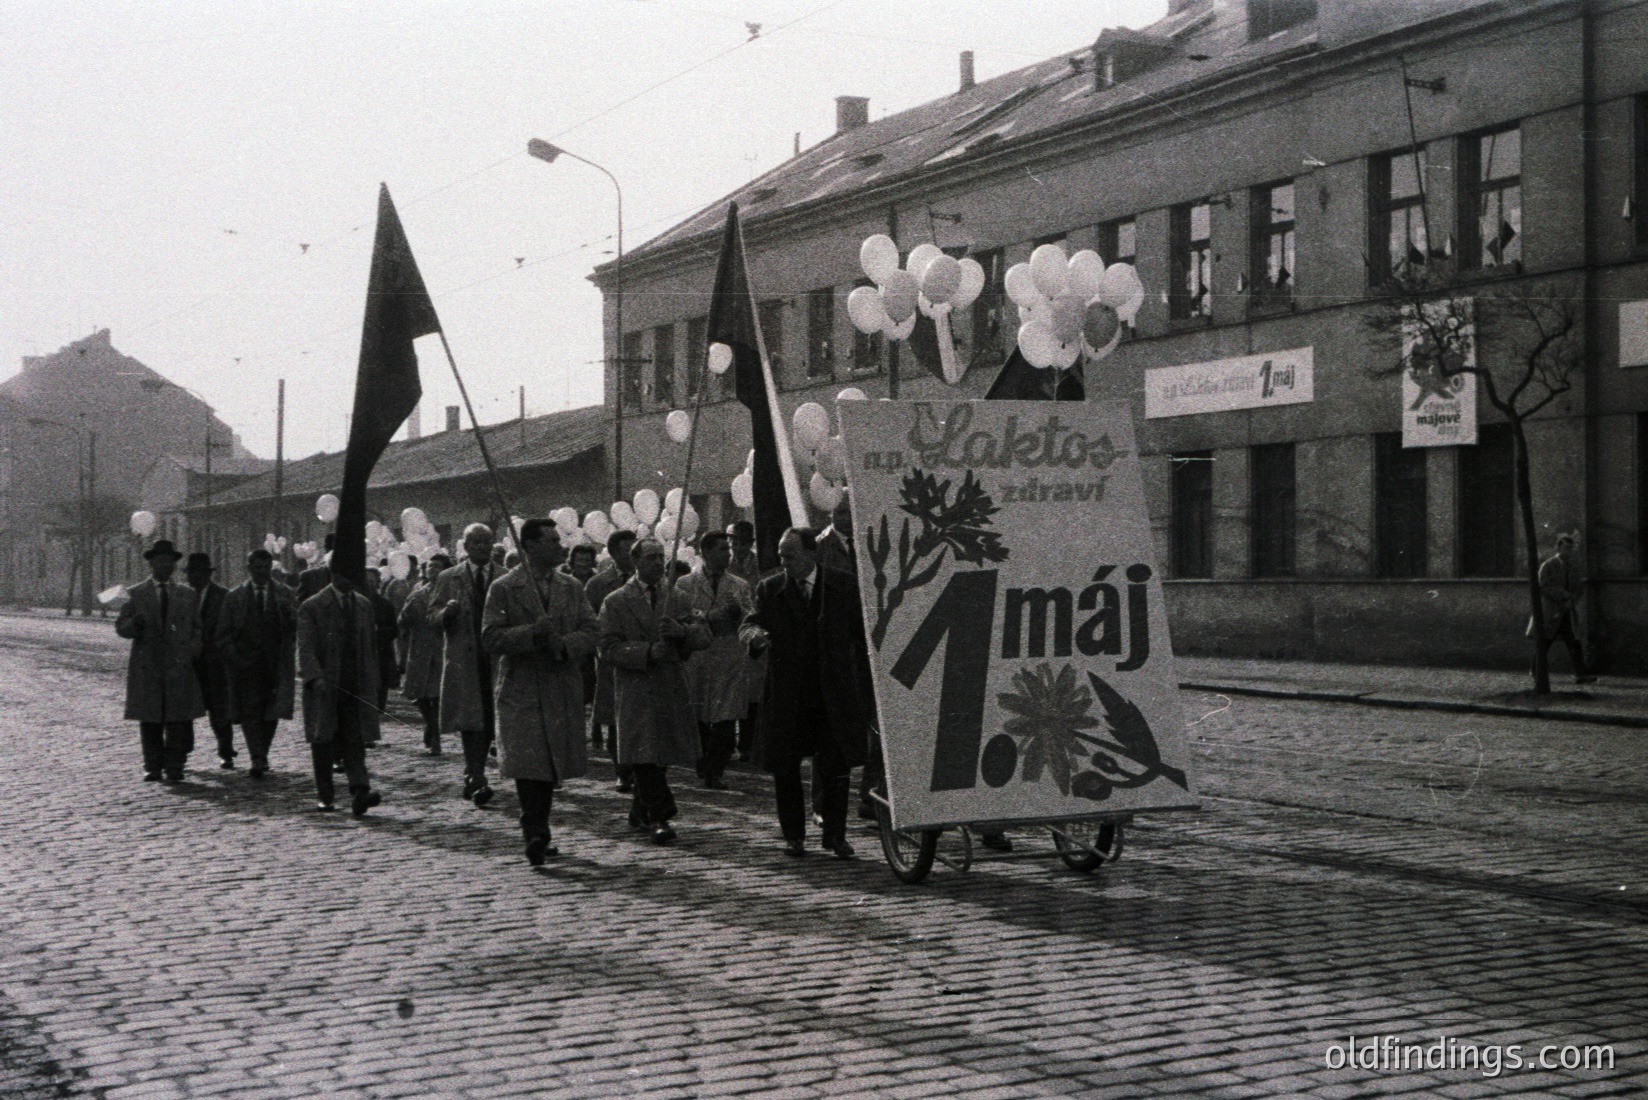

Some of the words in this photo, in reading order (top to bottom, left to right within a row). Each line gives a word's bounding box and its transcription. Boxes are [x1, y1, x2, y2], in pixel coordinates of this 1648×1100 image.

[1258, 359, 1275, 398] 1.
[1273, 365, 1296, 390] máj
[907, 402, 1129, 469] Laktos
[1000, 475, 1110, 502] zdraví
[889, 569, 1018, 793] 1.
[1001, 563, 1152, 672] máj
